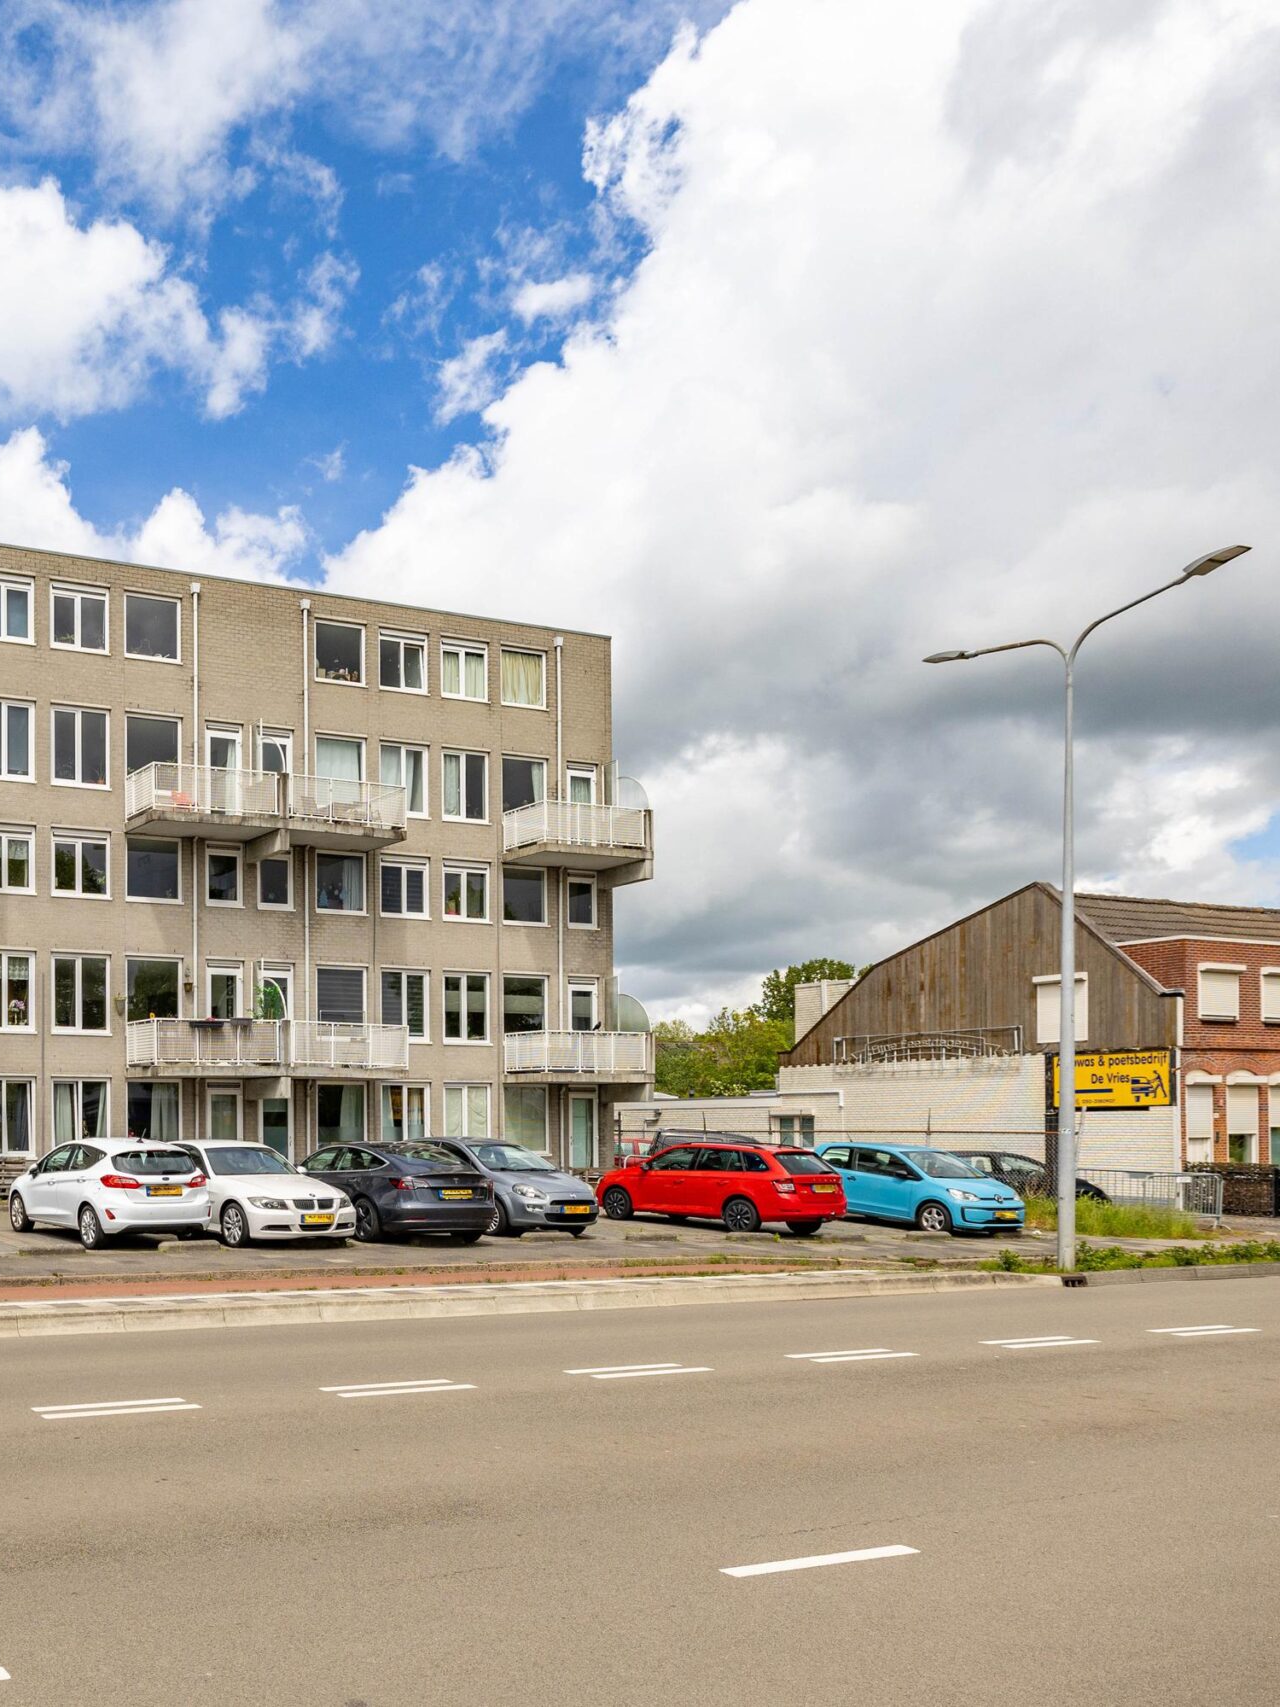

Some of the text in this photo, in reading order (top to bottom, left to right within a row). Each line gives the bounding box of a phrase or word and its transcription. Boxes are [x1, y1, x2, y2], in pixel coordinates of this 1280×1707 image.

[1098, 1055, 1105, 1067] &
[1108, 1051, 1167, 1068] poetsbedrijf
[1090, 1072, 1130, 1084] De Vries
